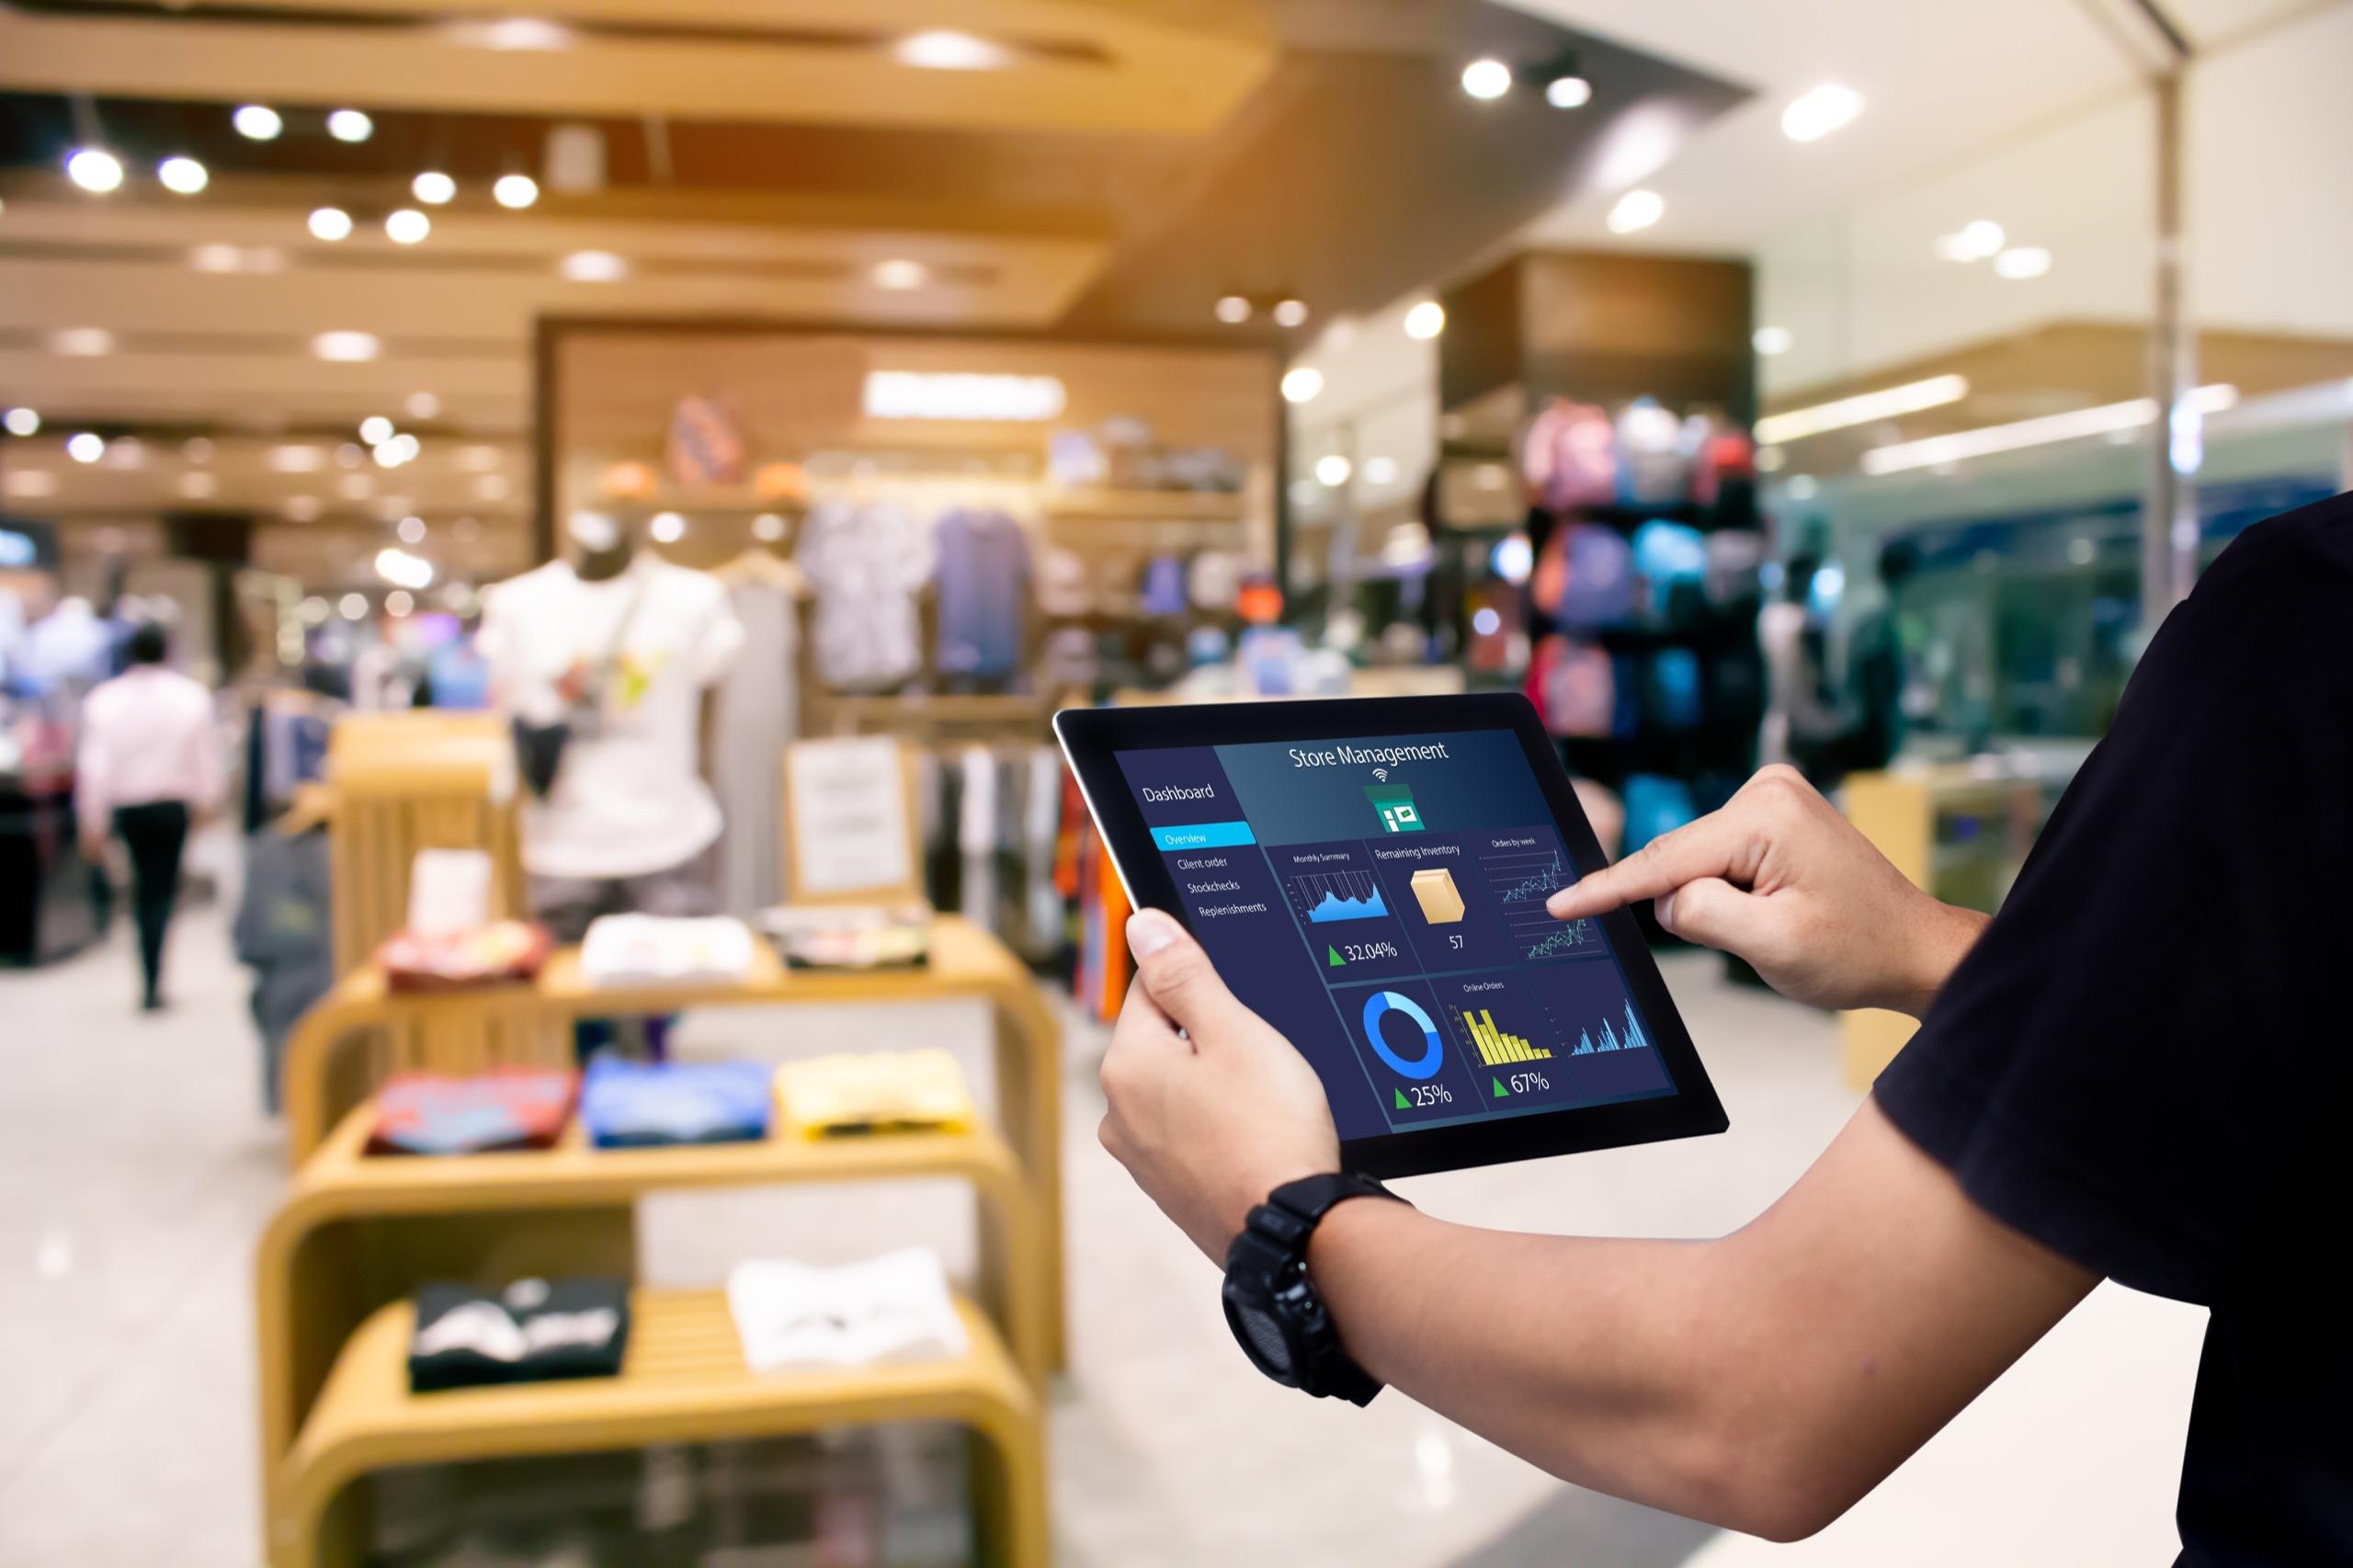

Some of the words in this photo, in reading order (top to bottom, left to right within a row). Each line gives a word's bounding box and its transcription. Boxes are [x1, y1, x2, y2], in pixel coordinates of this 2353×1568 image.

[1290, 746, 1336, 768] Store
[1337, 742, 1449, 766] Management
[1142, 783, 1215, 802] Dashboard
[1165, 833, 1207, 846] Overview
[1492, 838, 1512, 847] Orders
[1510, 838, 1520, 847] by
[1519, 836, 1536, 846] week
[1292, 853, 1321, 864] Monthly
[1320, 851, 1350, 861] Summary
[1374, 846, 1422, 860] Remaining
[1420, 845, 1461, 857] Inventory
[1204, 857, 1228, 869] order
[1187, 880, 1241, 894] Stockchecks
[1199, 902, 1267, 918] Replenishments
[1449, 935, 1464, 949] 57
[1345, 941, 1398, 961] 32.04%
[1463, 983, 1483, 993] Online
[1483, 982, 1505, 991] Orders
[1511, 1071, 1550, 1094] 67%
[1410, 1083, 1453, 1107] 25%
